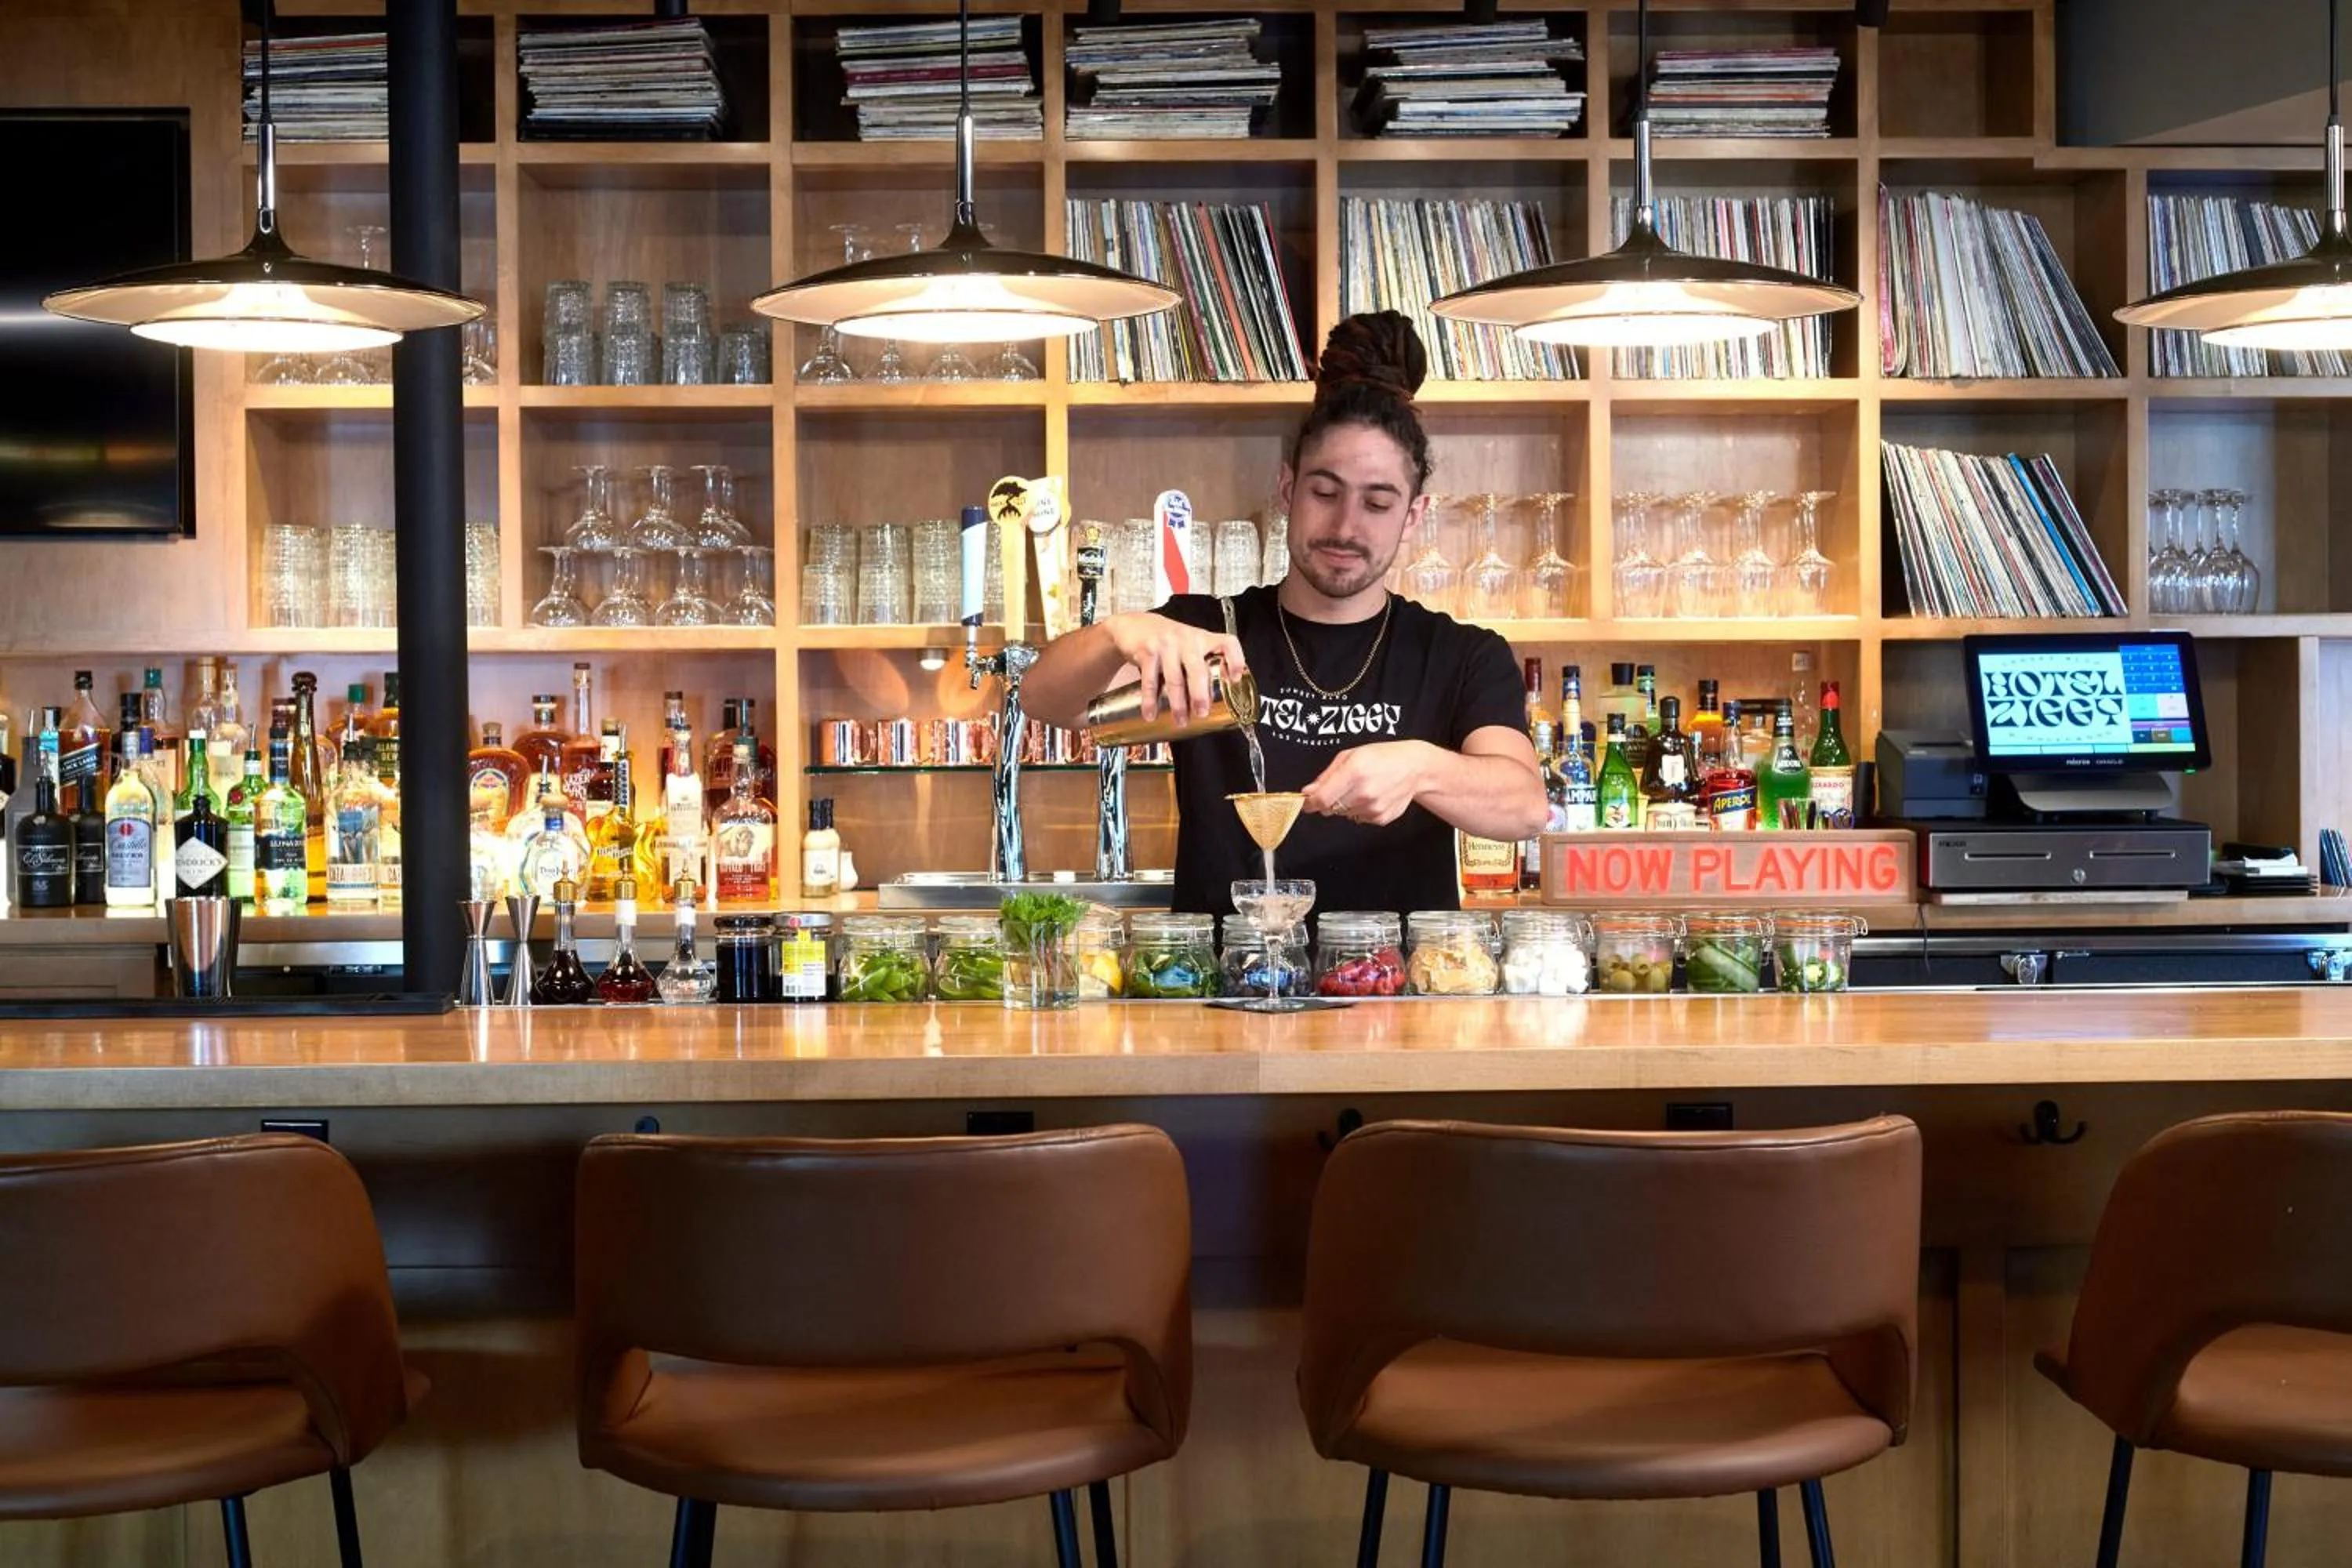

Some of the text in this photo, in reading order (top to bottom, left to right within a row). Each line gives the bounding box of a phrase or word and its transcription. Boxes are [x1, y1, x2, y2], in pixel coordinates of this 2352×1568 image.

[1280, 688, 1316, 699] SUNSET
[1984, 670, 2123, 696] HOTEL
[1260, 695, 1401, 736] TEL ZIGGY
[1987, 698, 2123, 728] ZIGGY
[1272, 731, 1290, 741] LOS
[1566, 789, 1596, 803] AMPA
[1713, 793, 1751, 812] APEROL
[1566, 846, 1898, 893] NOW PLAYING
